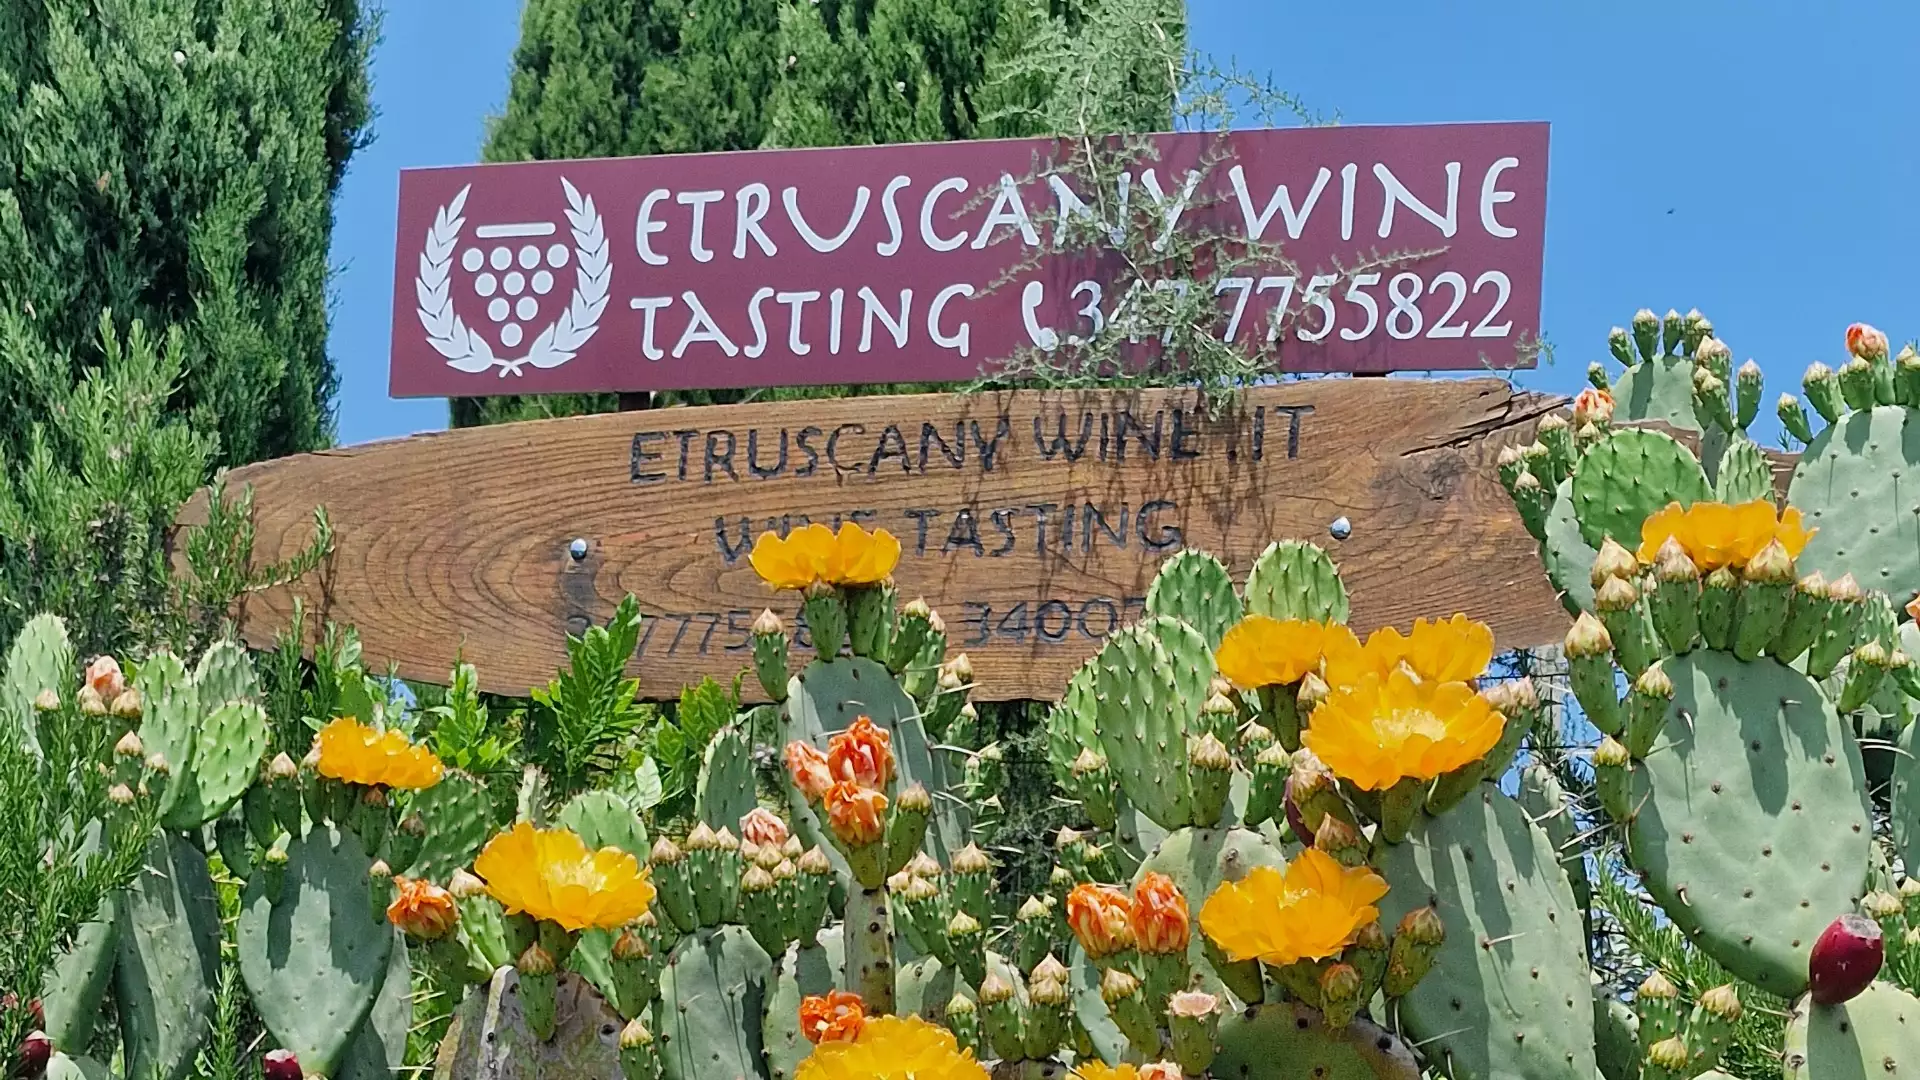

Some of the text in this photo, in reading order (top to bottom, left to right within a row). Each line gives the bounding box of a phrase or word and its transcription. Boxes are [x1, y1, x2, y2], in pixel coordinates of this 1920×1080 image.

[635, 157, 1520, 266] ETRUSCANY WINE
[629, 282, 975, 361] TASTING
[629, 414, 1009, 485] ETRUSCANY
[904, 500, 1182, 558] TASTING
